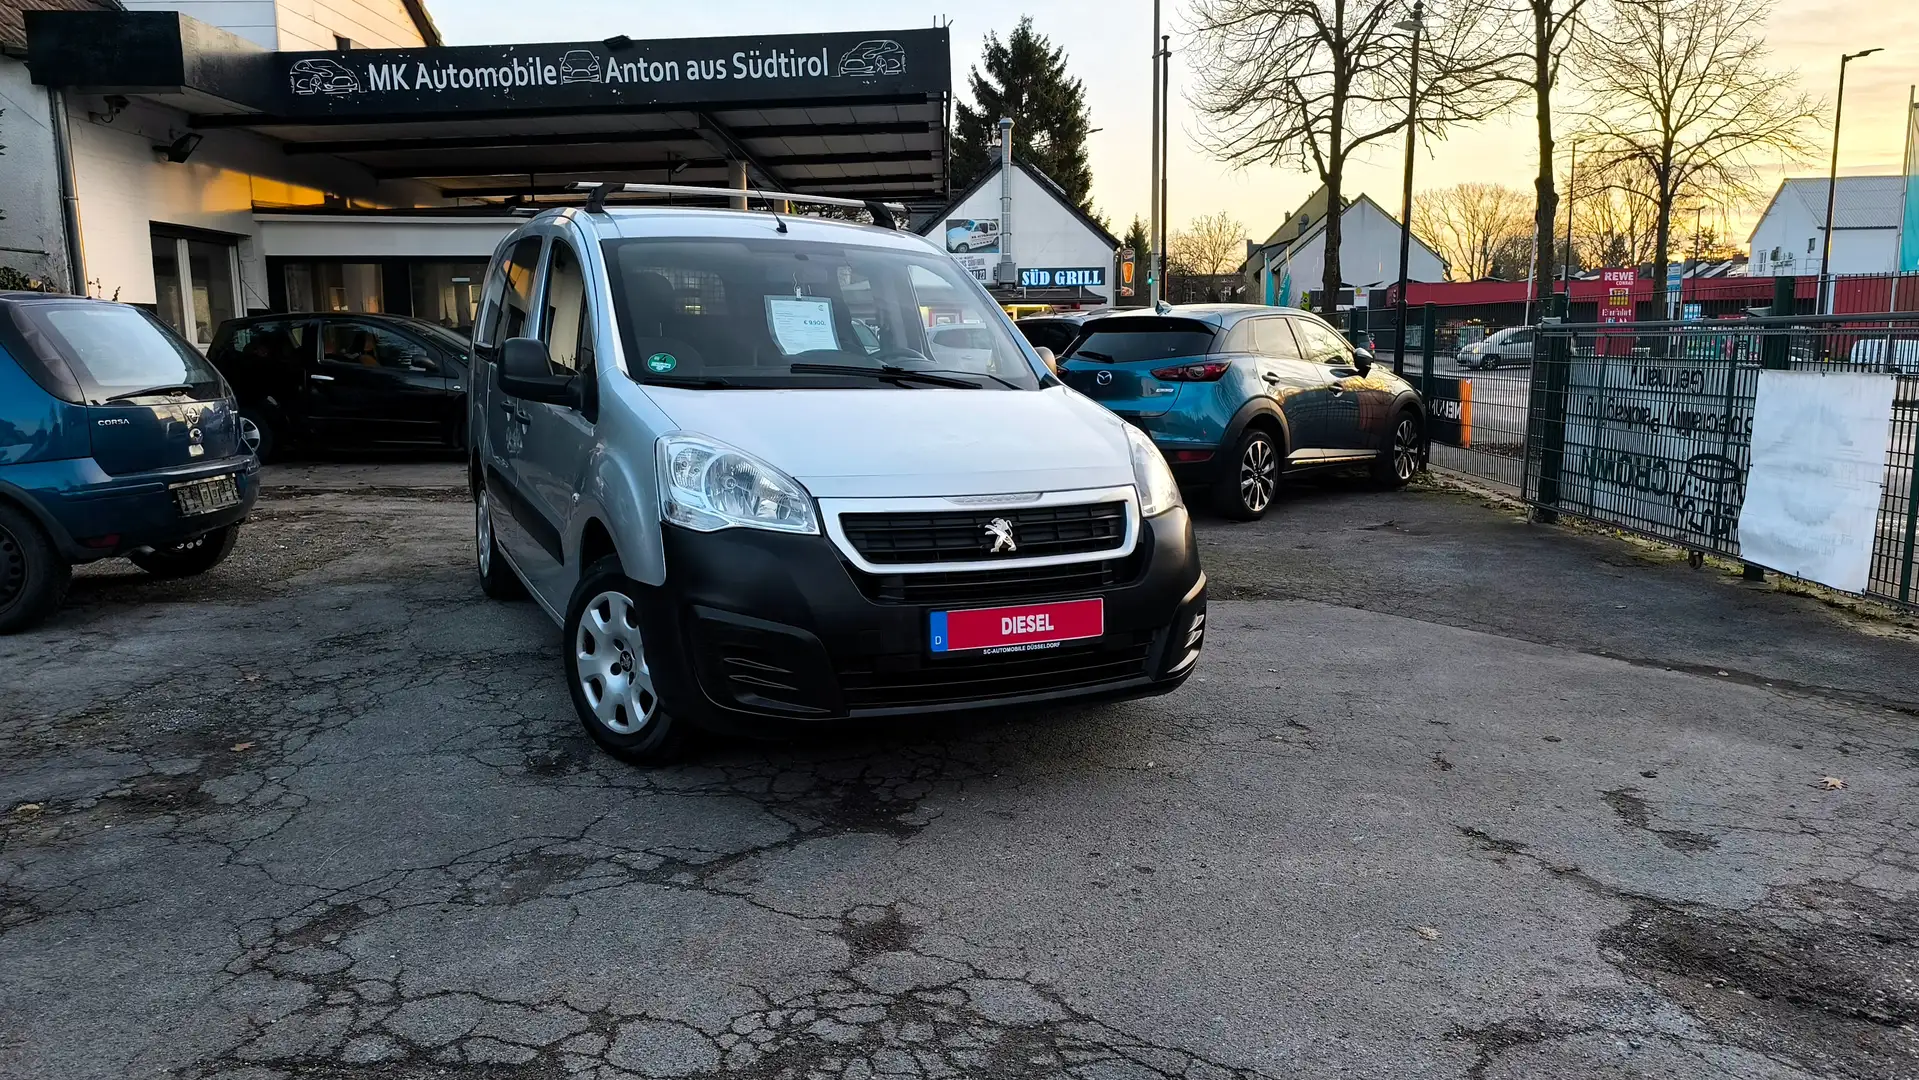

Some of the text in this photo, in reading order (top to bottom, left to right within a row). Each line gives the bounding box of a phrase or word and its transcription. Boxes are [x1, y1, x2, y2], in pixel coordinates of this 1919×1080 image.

[605, 48, 829, 84] Anton aus Südtirol
[368, 57, 557, 91] MK Automobile
[1021, 269, 1102, 286] SÜD GRILL
[1604, 272, 1634, 281] REWE
[97, 418, 130, 427] CORSA
[1001, 613, 1054, 635] DIESEL
[934, 635, 942, 645] D
[1027, 641, 1061, 652] DÜSSELDORF
